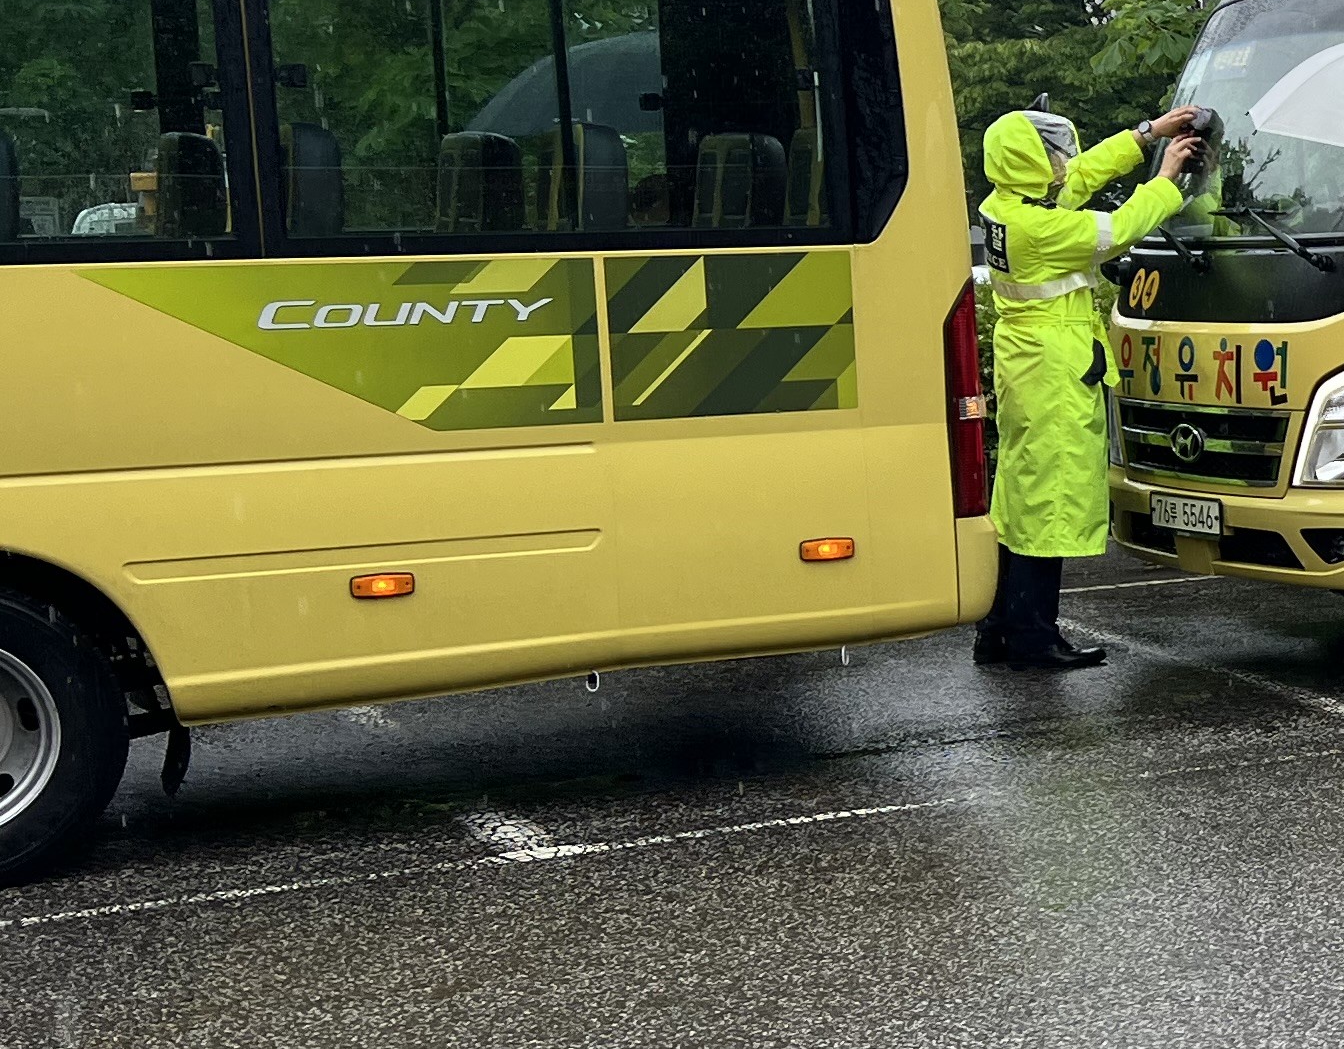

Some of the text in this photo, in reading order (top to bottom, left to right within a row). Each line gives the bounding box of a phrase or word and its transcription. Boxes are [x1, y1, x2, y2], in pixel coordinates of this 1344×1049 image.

[257, 298, 554, 329] COUNTY
[1119, 334, 1288, 406] 유정유치원
[1156, 498, 1214, 530] 76루 5546
